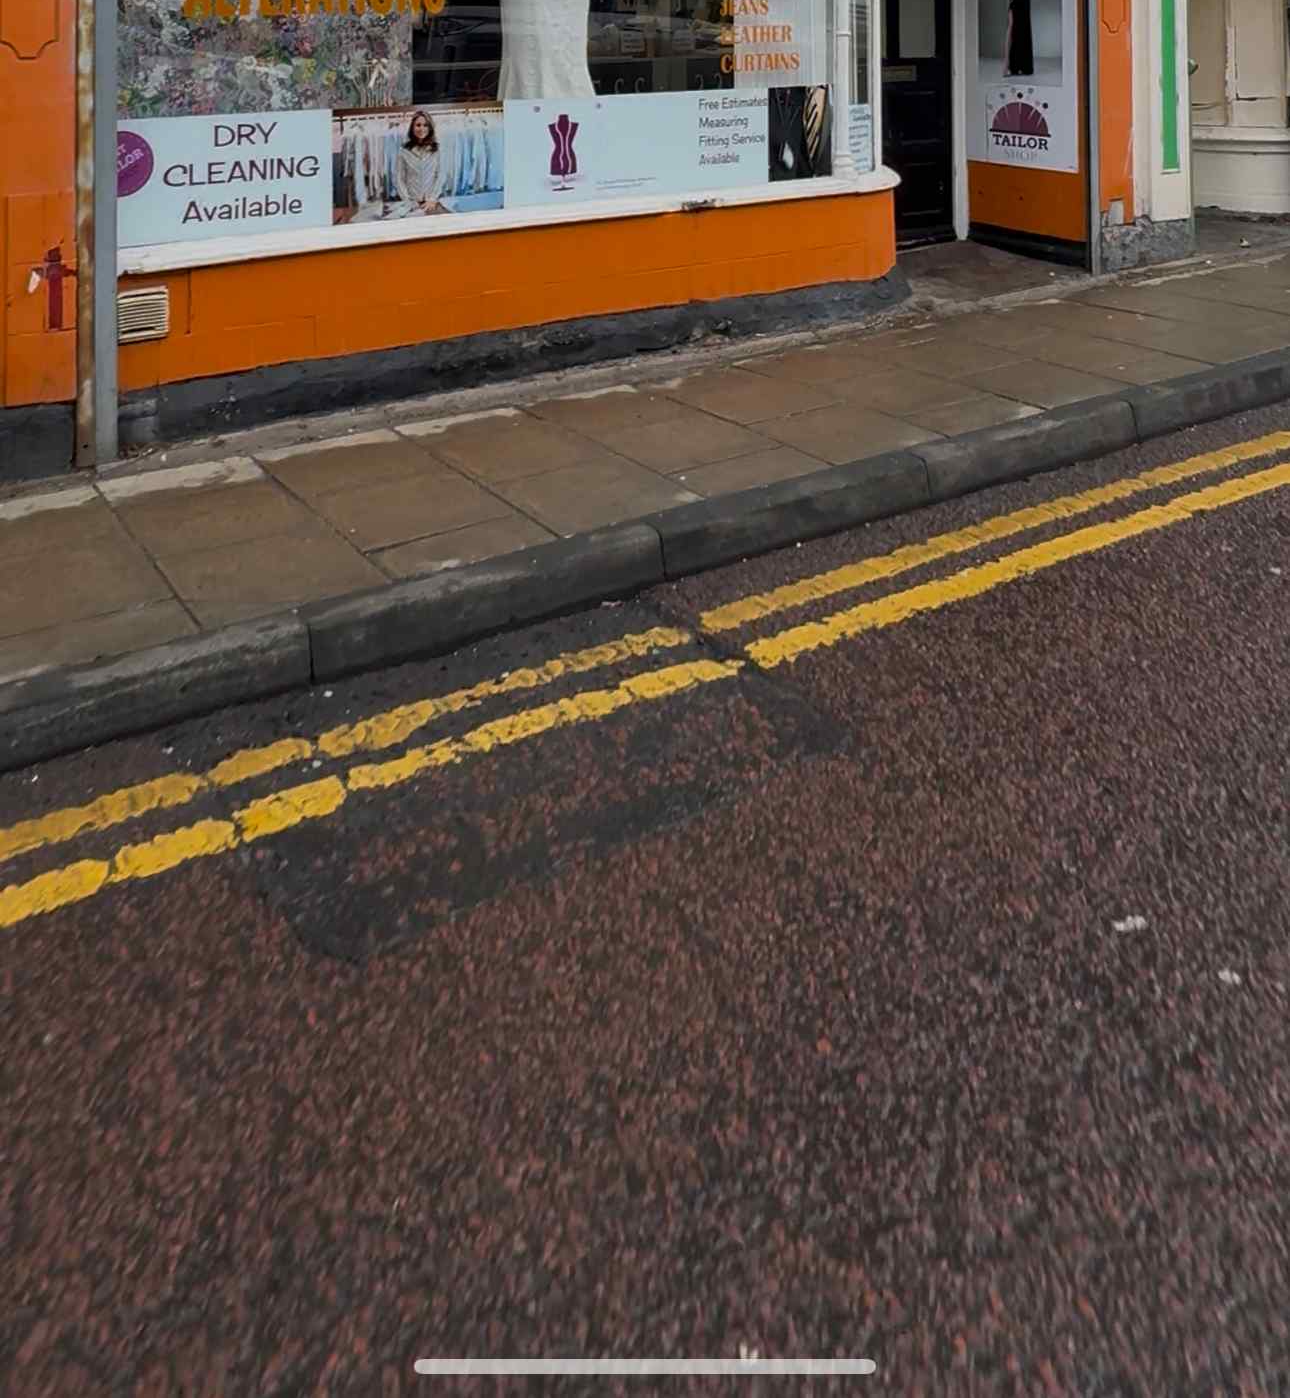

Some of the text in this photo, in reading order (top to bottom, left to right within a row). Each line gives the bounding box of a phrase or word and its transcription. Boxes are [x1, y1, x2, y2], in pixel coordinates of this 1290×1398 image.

[719, 24, 793, 45] LEATHER
[720, 52, 801, 74] CURTAINS
[698, 97, 719, 111] Free
[698, 116, 749, 130] Measuring
[213, 121, 279, 148] DRY
[698, 132, 766, 149] Fitting Service
[992, 133, 1049, 151] TAILOR
[698, 151, 740, 167] Available
[163, 155, 321, 187] CLEANING
[182, 193, 303, 224] Available
